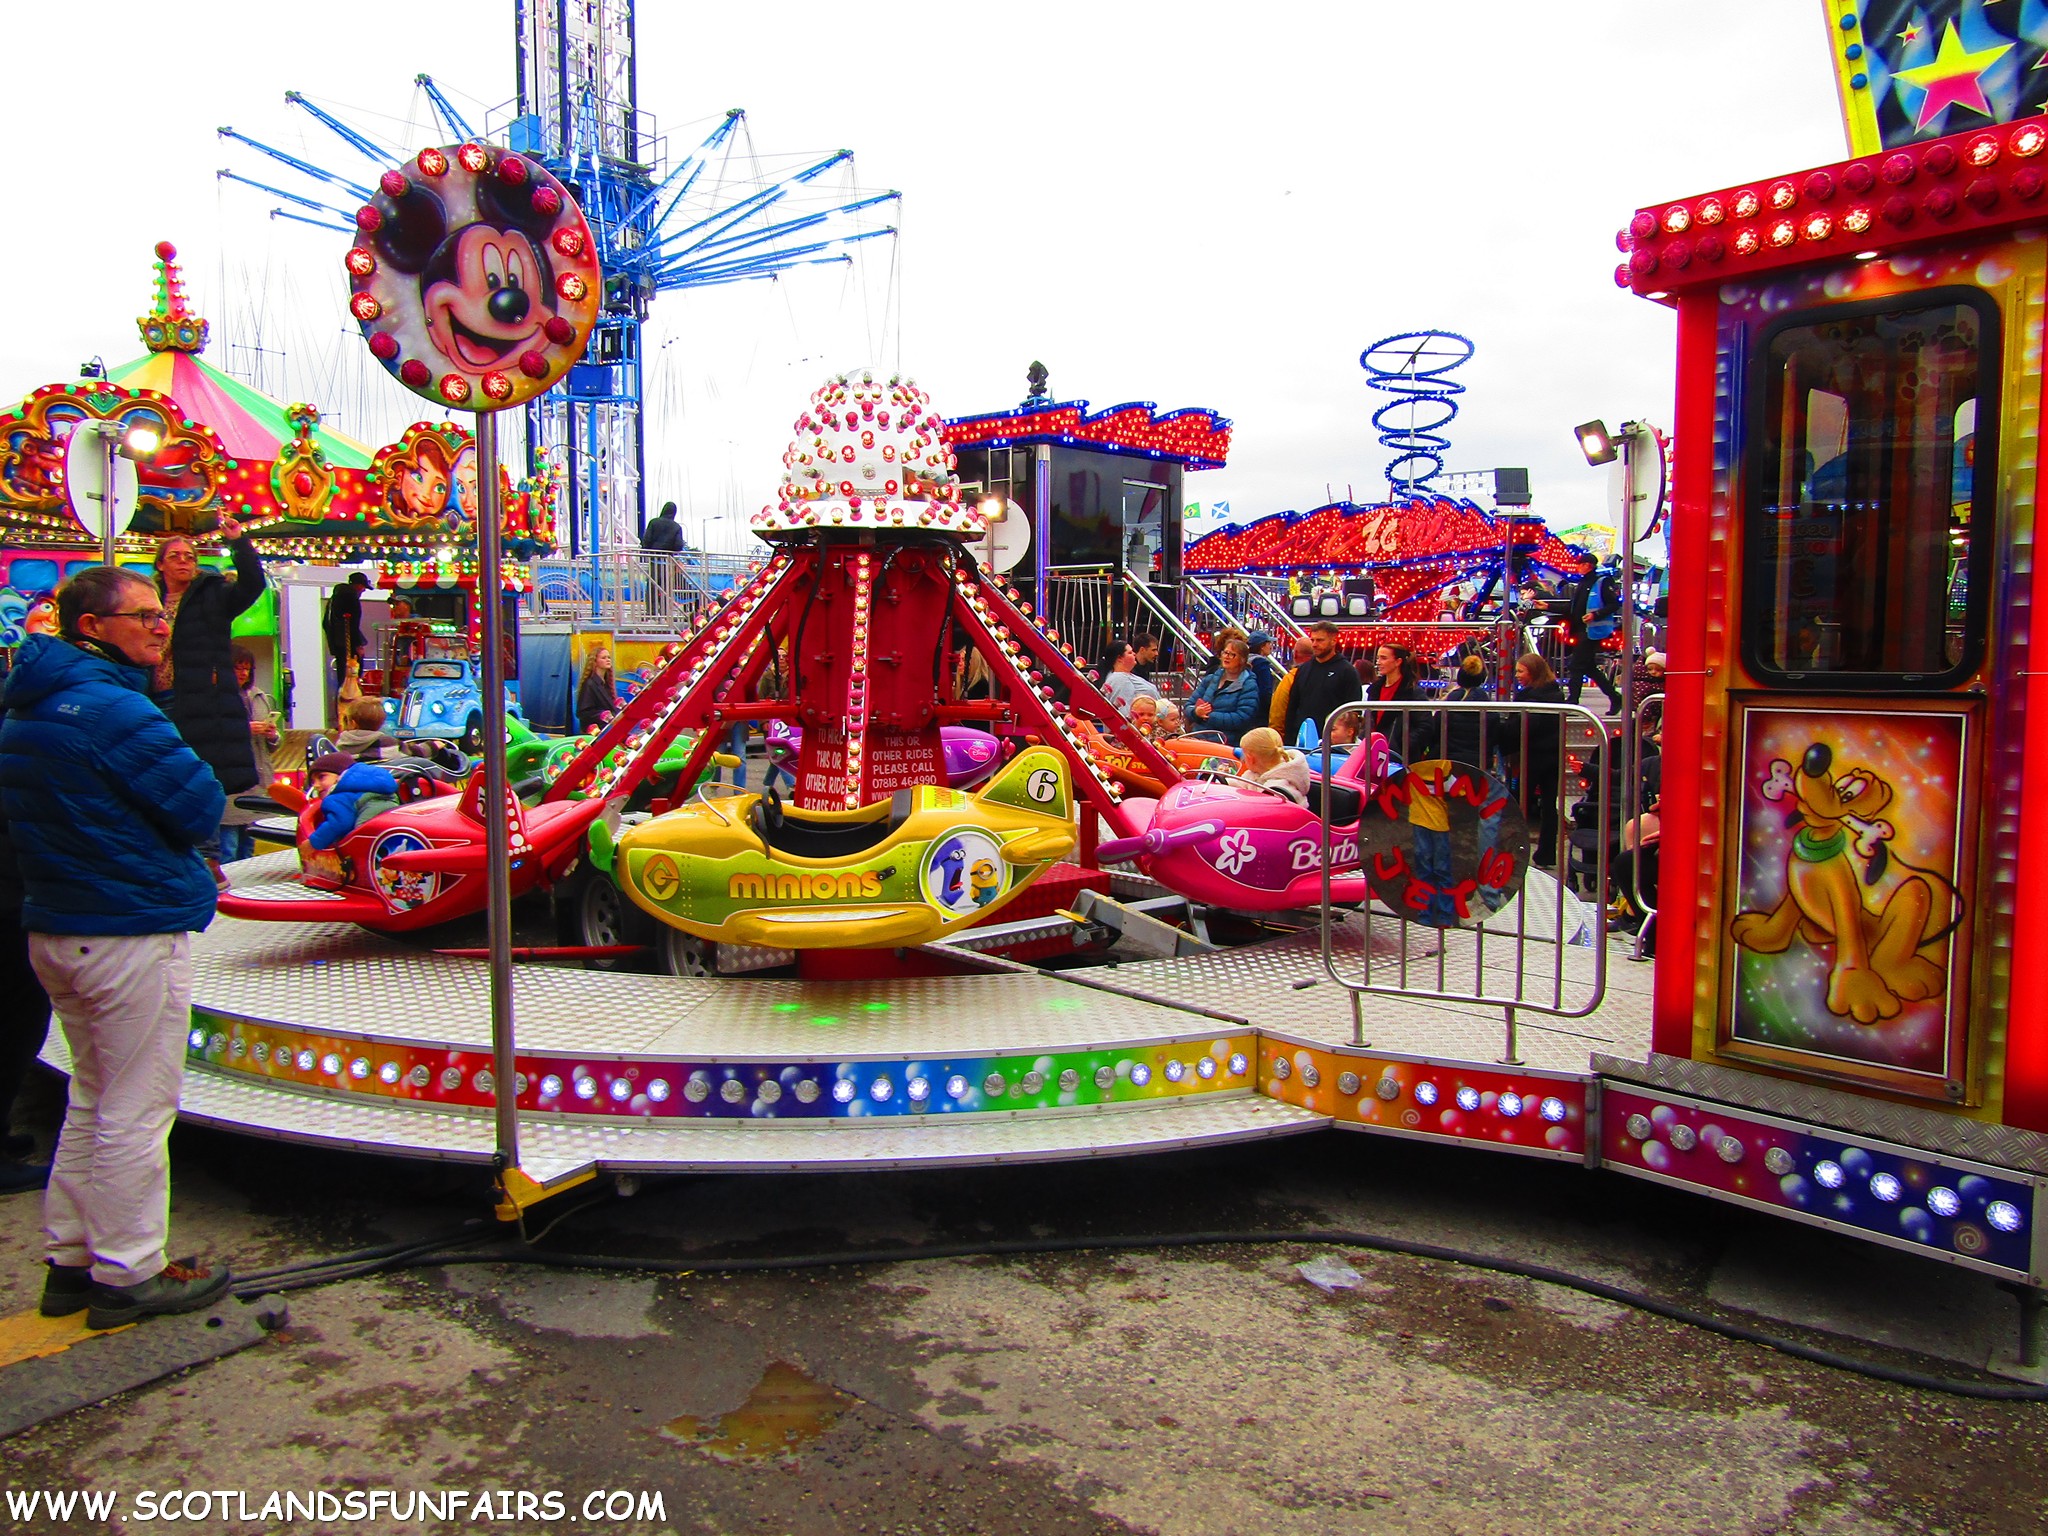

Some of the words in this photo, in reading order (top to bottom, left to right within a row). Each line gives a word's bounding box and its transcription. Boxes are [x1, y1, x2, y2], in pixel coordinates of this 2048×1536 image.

[774, 721, 791, 738] 2
[885, 736, 904, 747] THIS
[906, 736, 921, 747] OR
[816, 750, 831, 769] THIS
[832, 751, 842, 770] OR
[872, 750, 903, 762] OTHER
[906, 748, 934, 760] RIDES
[1105, 754, 1132, 770] TOY
[1376, 751, 1388, 778] 7
[872, 763, 909, 775] PLEASE
[911, 761, 935, 774] CALL
[805, 772, 827, 793] OTHER
[829, 776, 847, 796] RIDE
[872, 777, 898, 789] 07818
[901, 774, 937, 787] 464990
[1026, 768, 1059, 803] 6
[1378, 767, 1508, 820] MINI
[729, 871, 883, 900] minions
[1373, 846, 1514, 919] JETS
